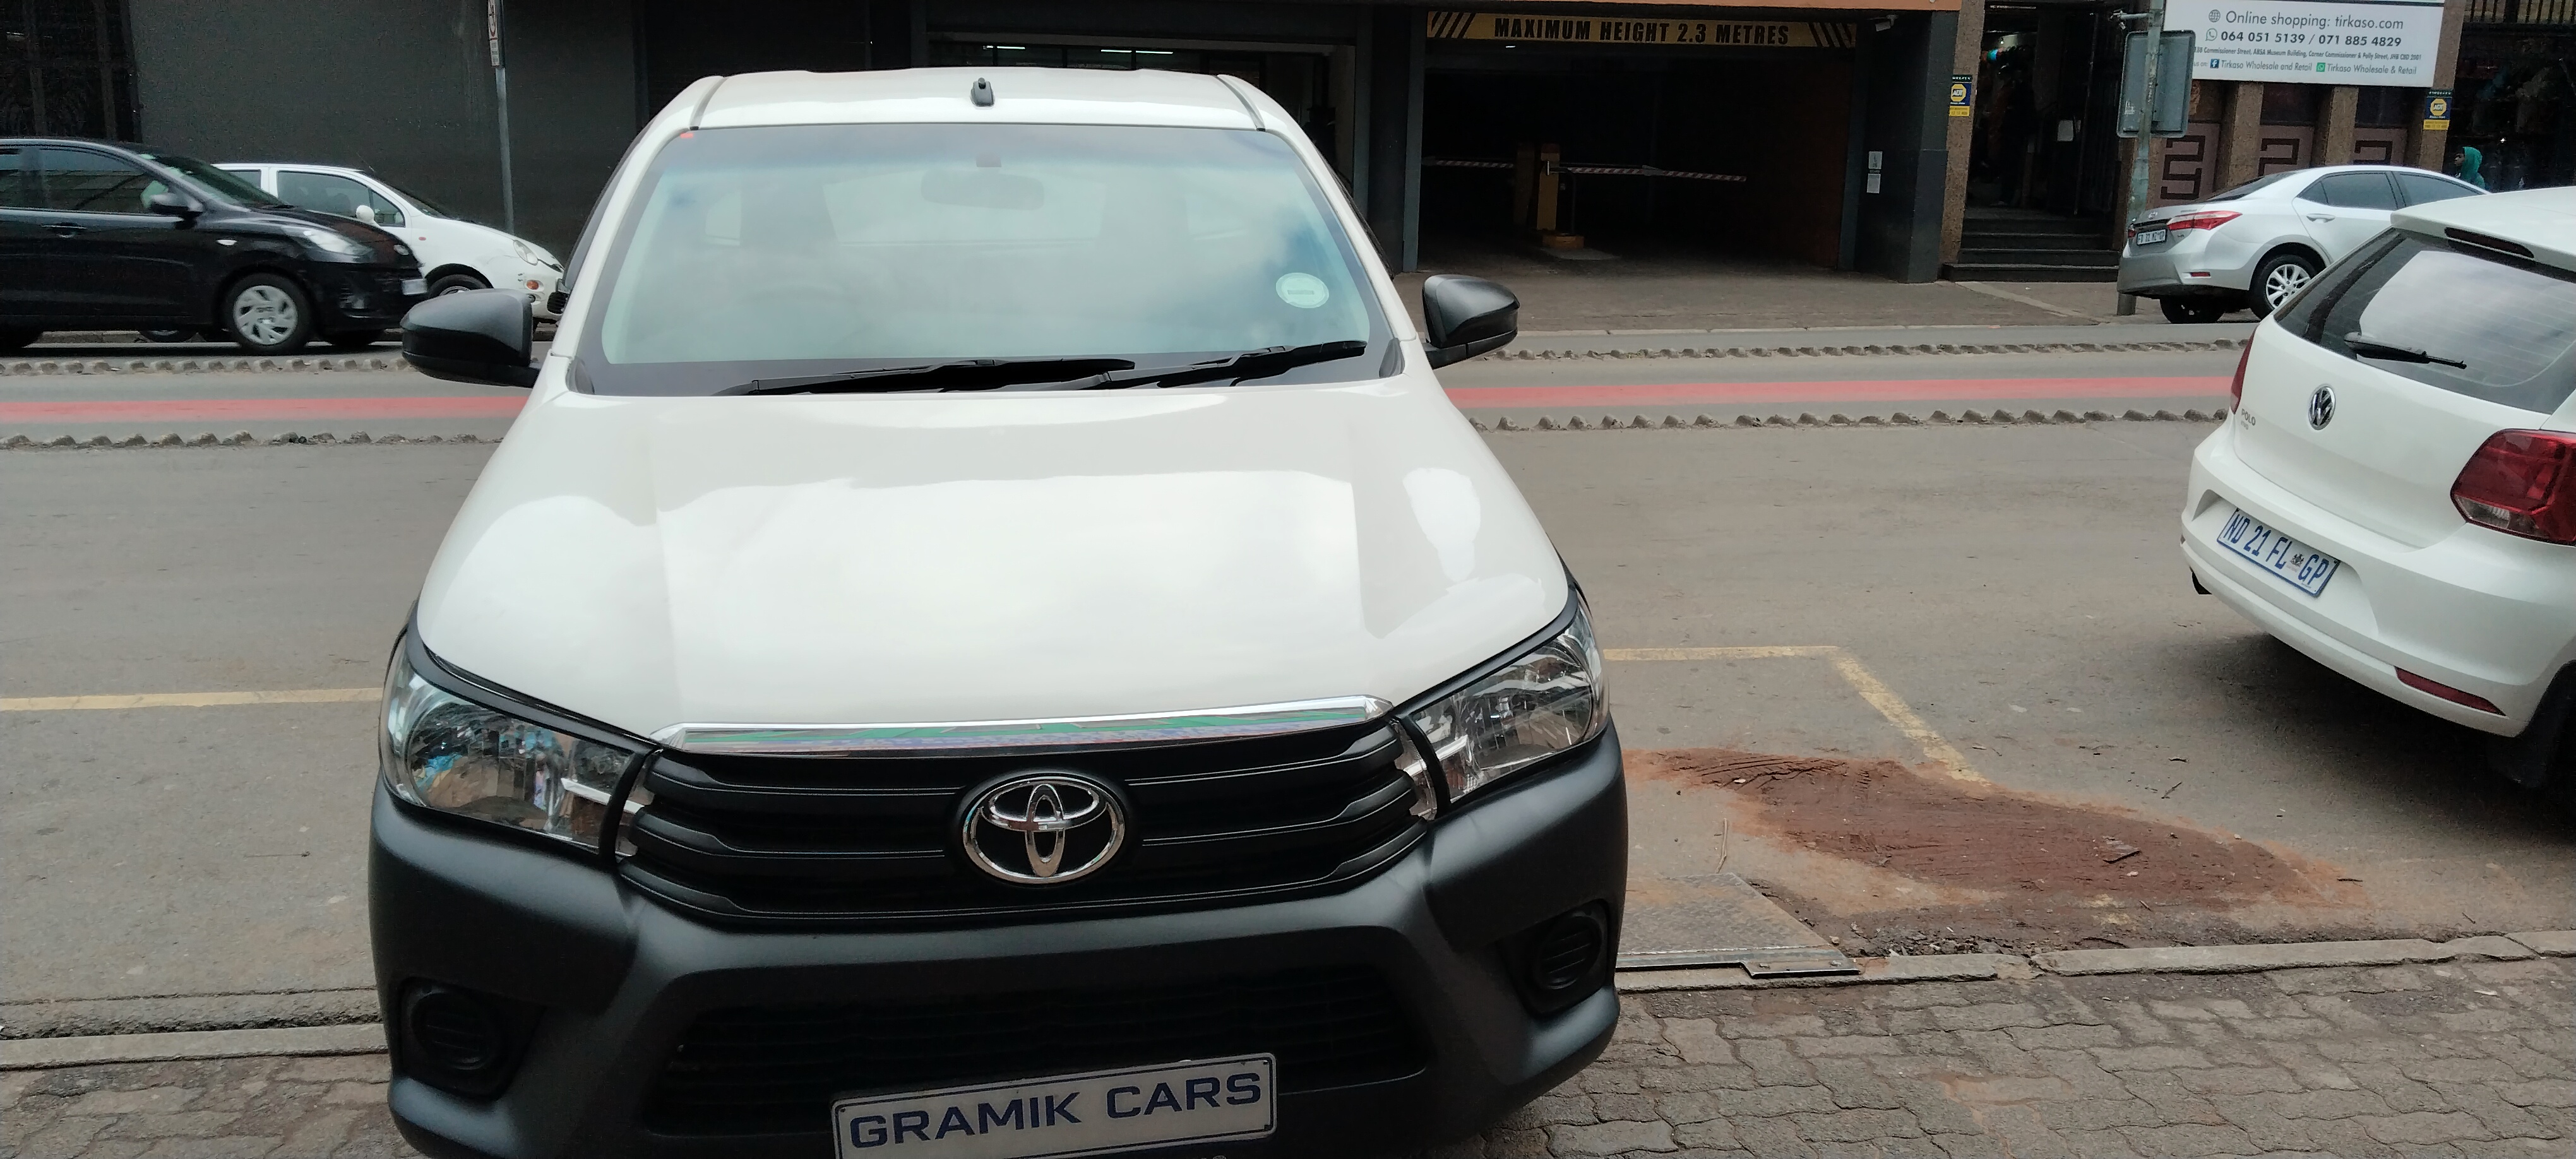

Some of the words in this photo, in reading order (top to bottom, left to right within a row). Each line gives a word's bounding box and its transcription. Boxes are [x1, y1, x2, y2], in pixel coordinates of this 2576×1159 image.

[2226, 11, 2267, 24] Online
[2271, 12, 2330, 30] shopping:
[2335, 15, 2404, 29] tirkaso.com
[1494, 18, 1590, 40] MAXIMUM
[1600, 21, 1669, 42] HEIGHT
[1678, 23, 1707, 43] 2.3
[1716, 23, 1788, 45] METRES
[2221, 32, 2243, 41] 064
[2248, 32, 2269, 42] 051
[2275, 33, 2305, 43] 5139
[2319, 35, 2339, 45] 071
[2345, 36, 2367, 45] 885
[2371, 37, 2401, 46] 4829
[2222, 59, 2244, 69] Tirkaso
[2246, 61, 2279, 70] Wholesale
[2281, 62, 2293, 71] and
[2294, 62, 2312, 71] Retail
[2327, 63, 2351, 72] Tirkaso
[2354, 64, 2388, 73] Wholesale
[2391, 66, 2396, 74] &
[2399, 66, 2417, 74] Retail
[2241, 408, 2256, 425] POLO
[2223, 514, 2250, 544] ND
[2243, 525, 2271, 556] 21
[2265, 537, 2293, 569] FL
[2298, 554, 2329, 585] GP
[850, 1091, 1082, 1149] GRAMIK
[1106, 1073, 1261, 1119] CARS
